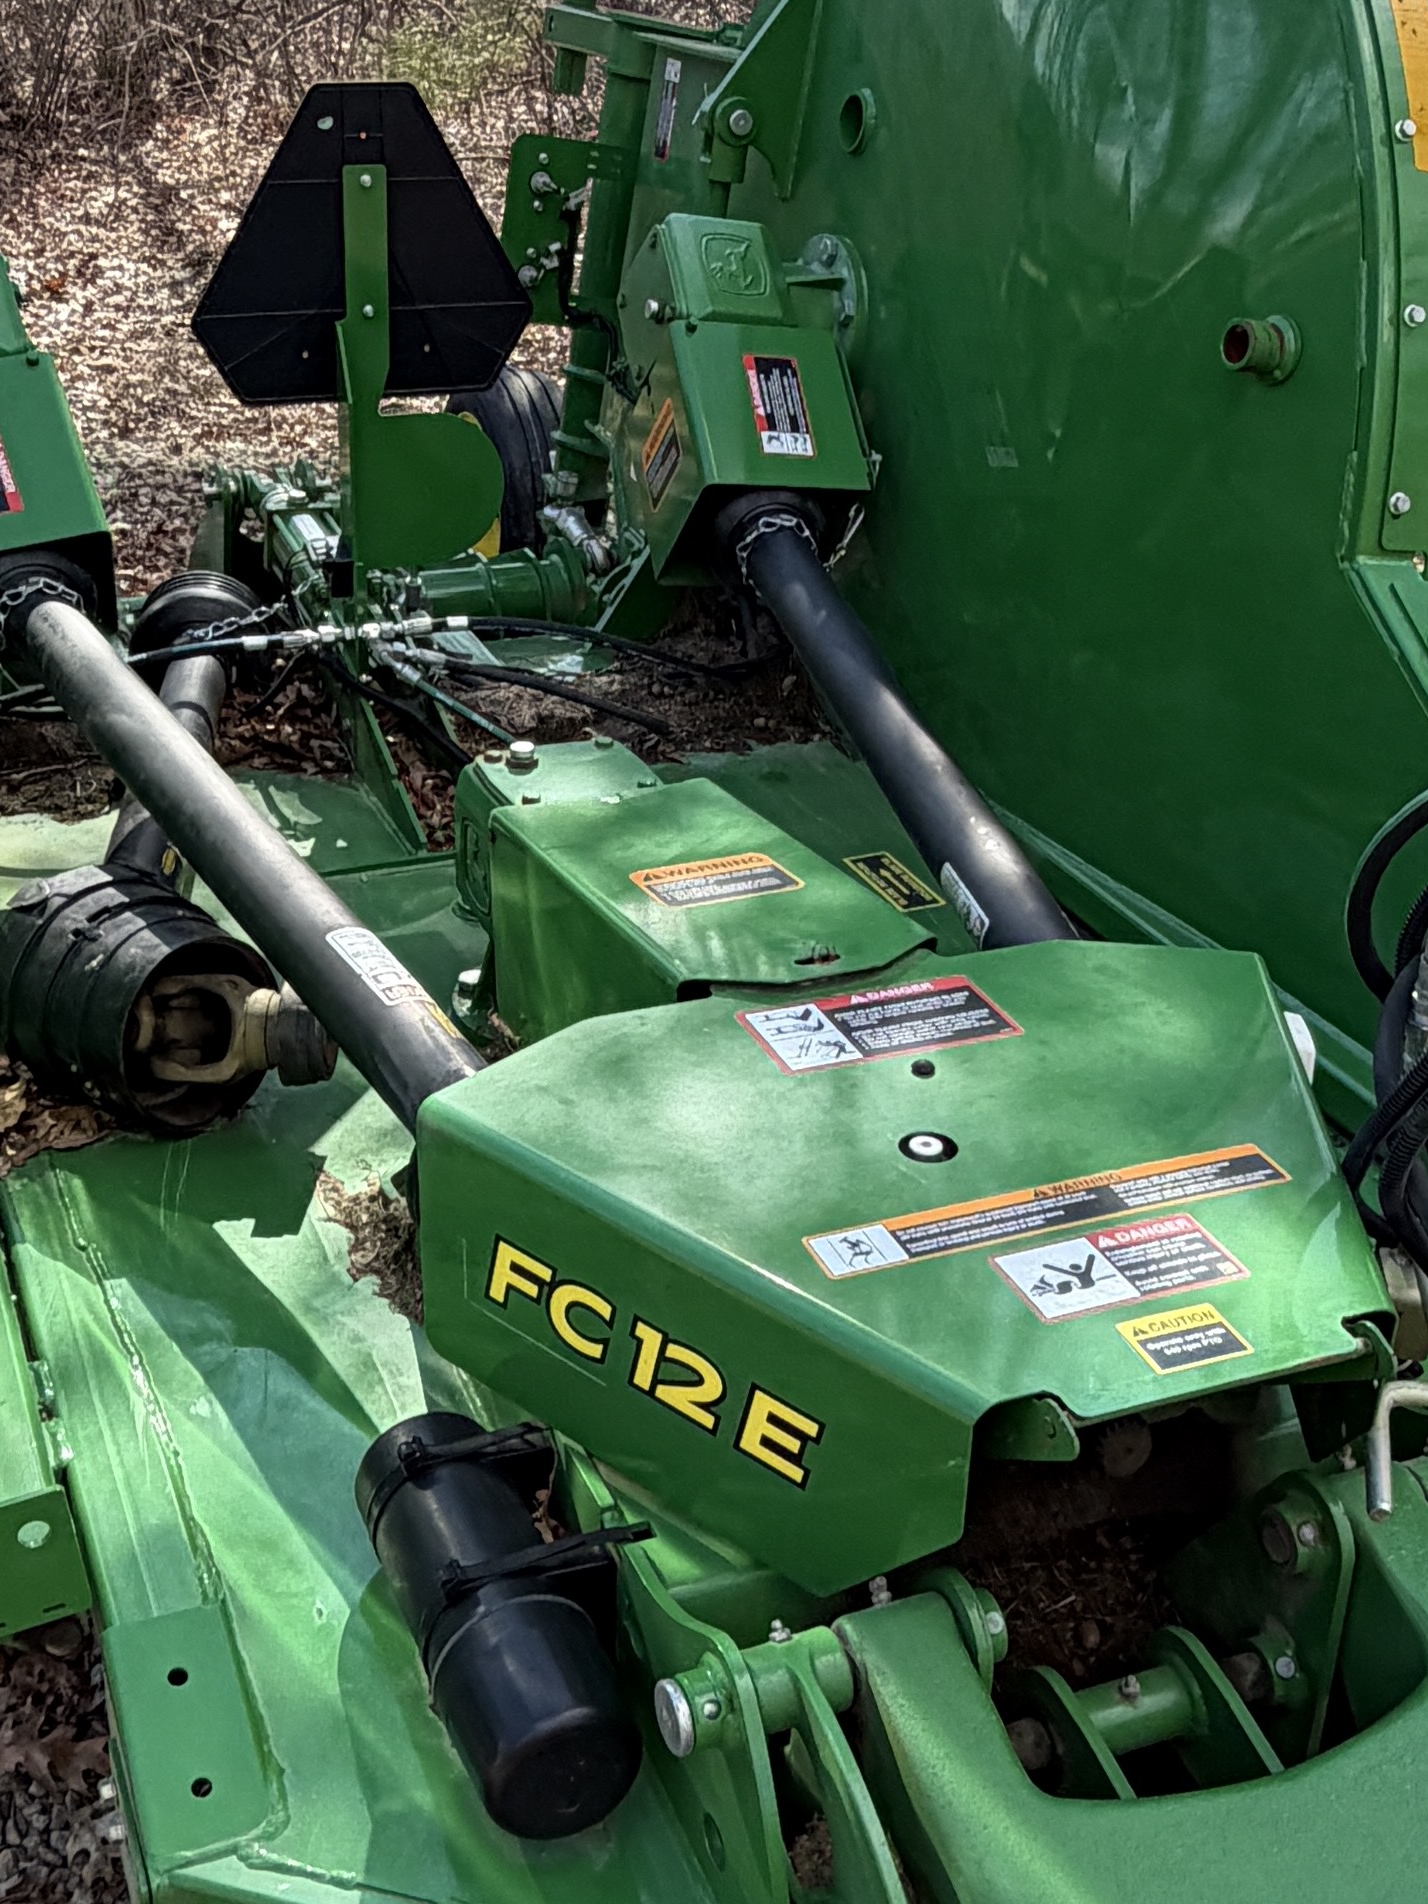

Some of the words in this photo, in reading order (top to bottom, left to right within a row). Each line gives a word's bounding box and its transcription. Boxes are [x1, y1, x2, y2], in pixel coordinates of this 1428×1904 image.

[663, 854, 765, 879] WARNING
[867, 982, 934, 1002] DANGER
[1047, 1171, 1122, 1195] WARNING
[1114, 1218, 1192, 1242] DANGER
[1148, 1309, 1215, 1332] CAUTION
